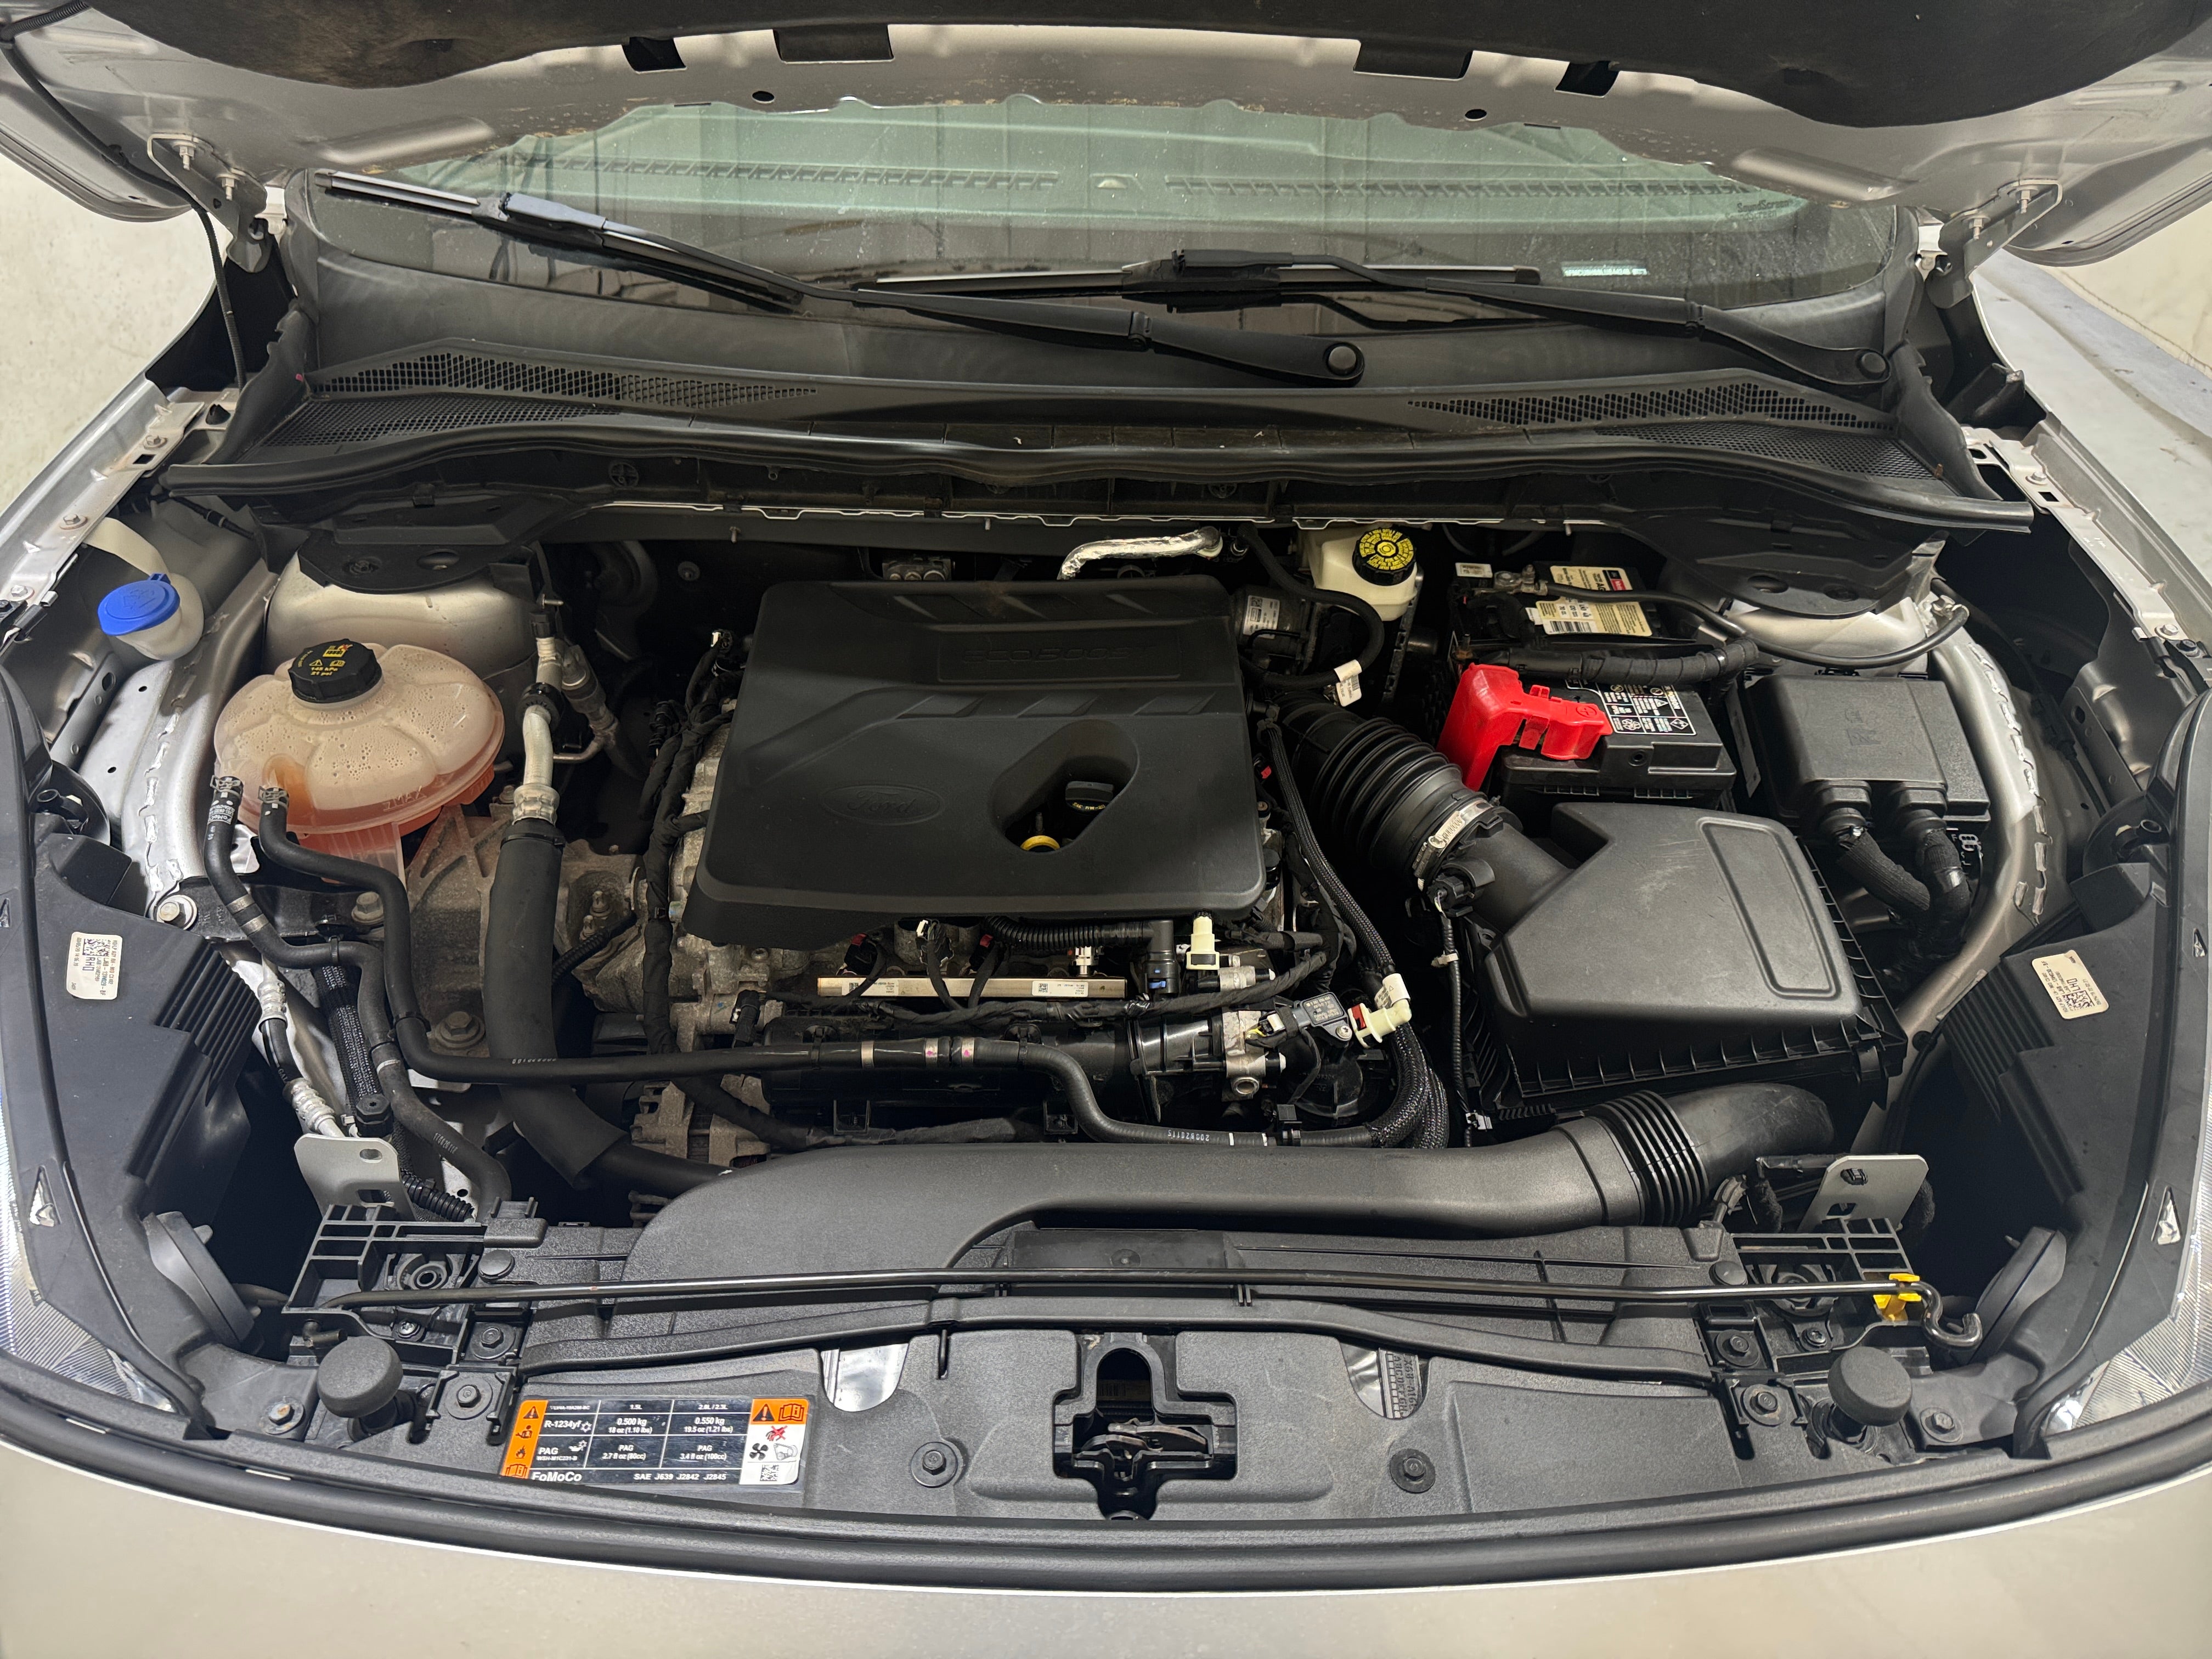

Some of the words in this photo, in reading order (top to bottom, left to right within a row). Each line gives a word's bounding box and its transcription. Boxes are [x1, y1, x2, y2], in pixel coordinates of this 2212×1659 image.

[1667, 691, 1681, 710] POISON
[544, 1420, 582, 1430] R-1234yf
[617, 1418, 637, 1426] 0.500
[637, 1418, 647, 1426] kg
[715, 1417, 725, 1426] kg
[640, 1426, 653, 1435] lbs)
[721, 1425, 733, 1434] lbs)
[538, 1447, 558, 1455] PAG
[531, 1471, 583, 1482] FoMoCo
